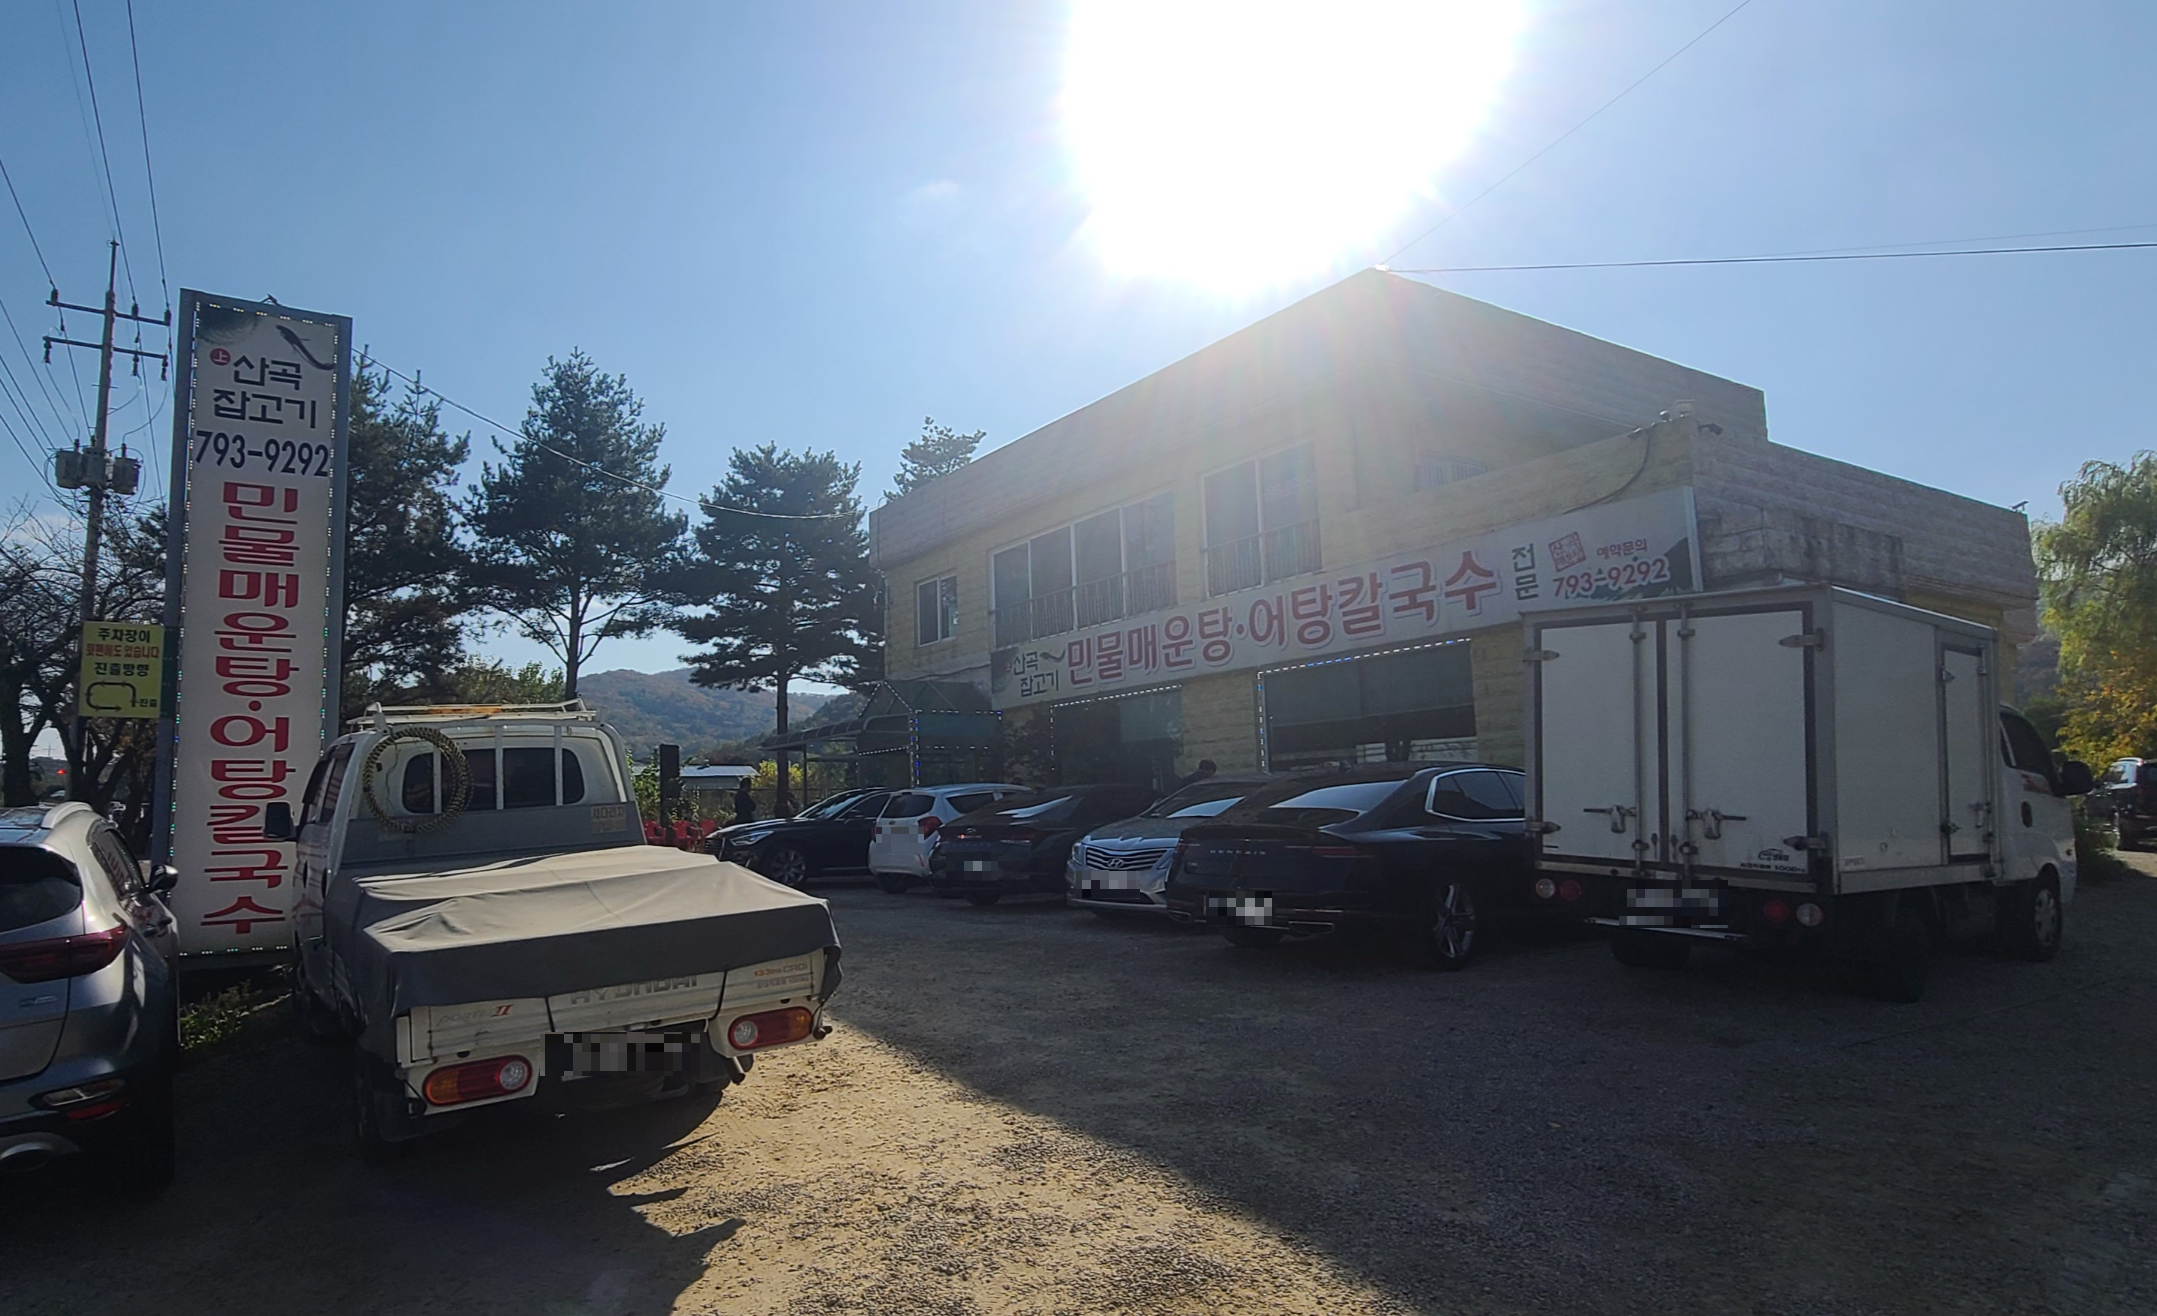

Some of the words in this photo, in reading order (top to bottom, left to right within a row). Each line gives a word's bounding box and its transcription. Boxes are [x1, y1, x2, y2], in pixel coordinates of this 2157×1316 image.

[233, 355, 302, 391] 산곡
[213, 389, 317, 429] 잡고기
[195, 430, 329, 477] 793-9292
[1597, 538, 1648, 560] 예약문의
[1552, 557, 1668, 597] 793-9292
[98, 628, 151, 643] 주차장이
[123, 645, 159, 659] 있습니다
[1013, 650, 1039, 676] 산곡
[94, 662, 150, 677] 진출방향
[1019, 669, 1060, 698] 잡고기
